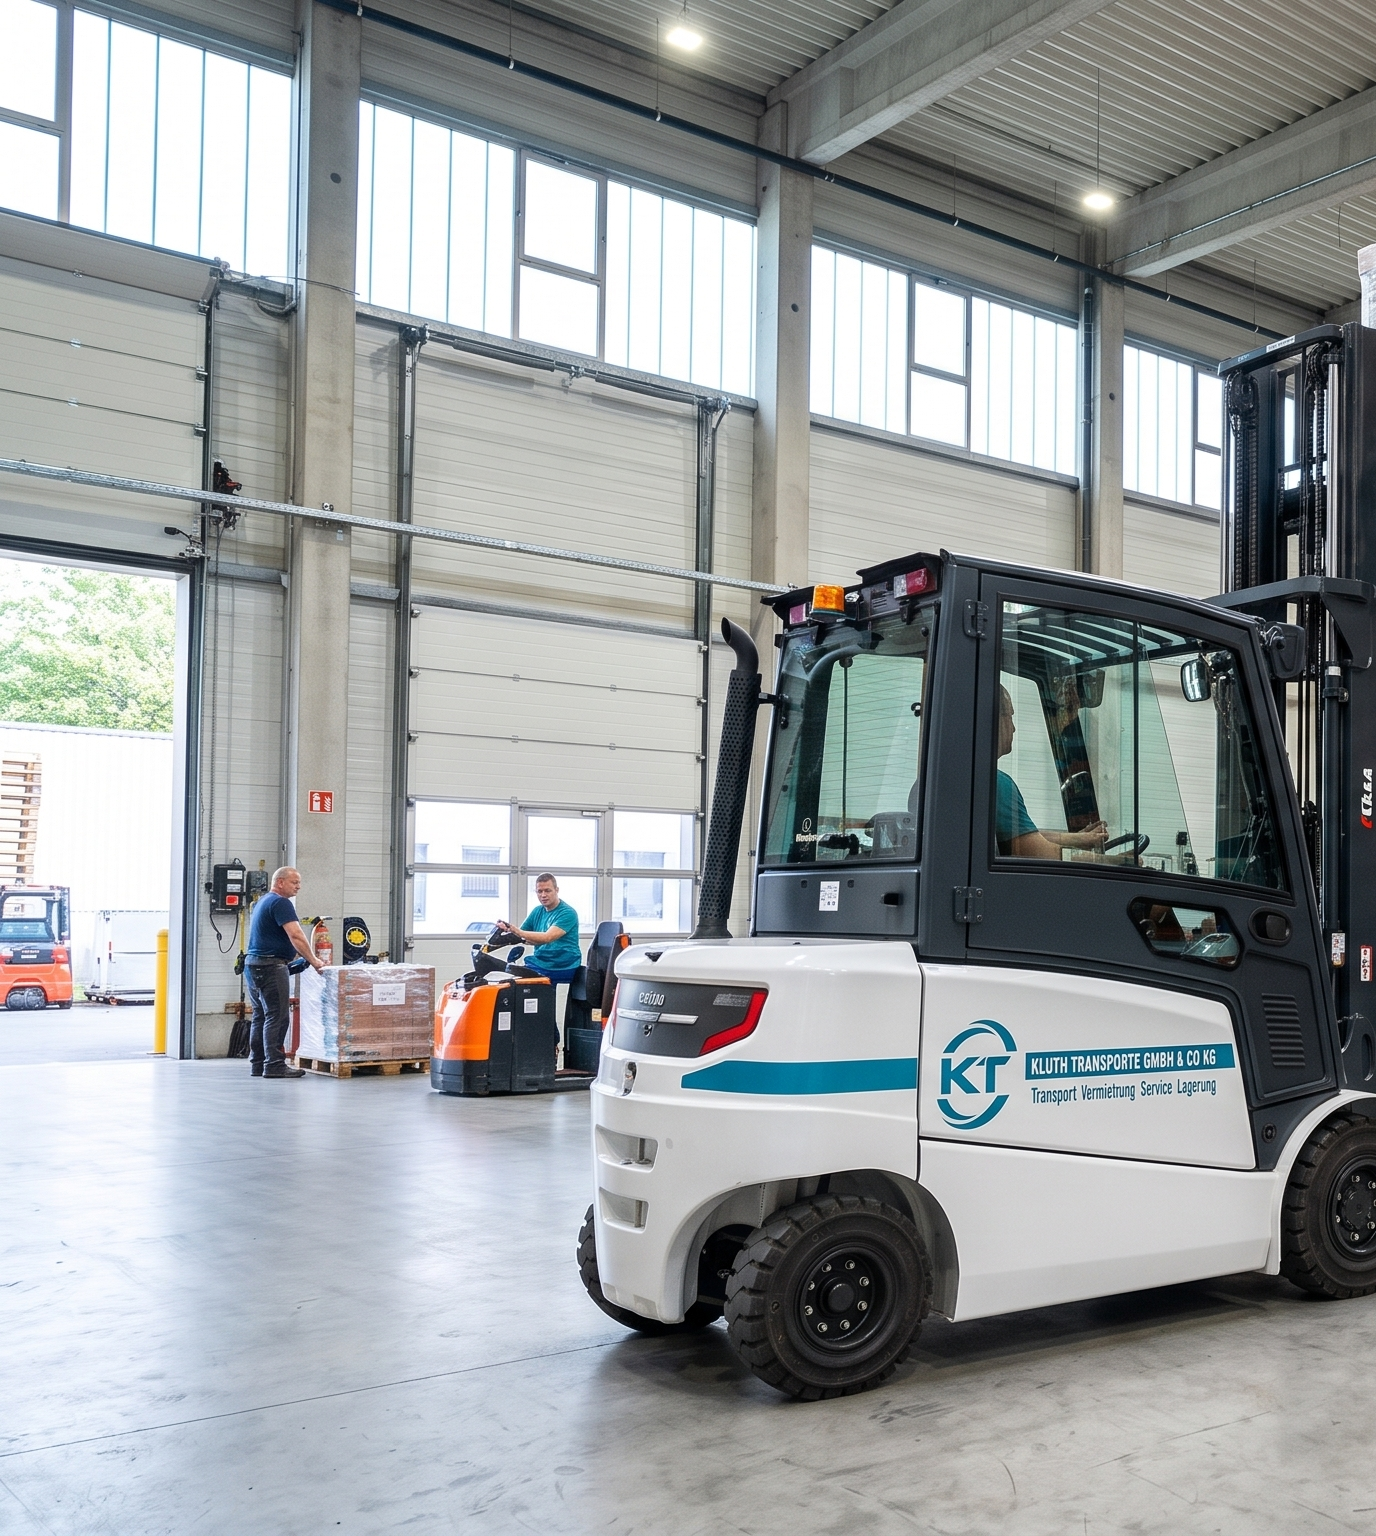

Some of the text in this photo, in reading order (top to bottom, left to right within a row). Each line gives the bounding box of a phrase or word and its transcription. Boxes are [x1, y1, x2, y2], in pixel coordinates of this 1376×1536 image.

[940, 1055, 1011, 1095] KT
[1031, 1048, 1216, 1075] KLUTH TRANSPORTE GMBH & CO KG
[1031, 1085, 1077, 1106] Transport
[1140, 1079, 1173, 1097] Service
[1177, 1078, 1217, 1097] Lagerung
